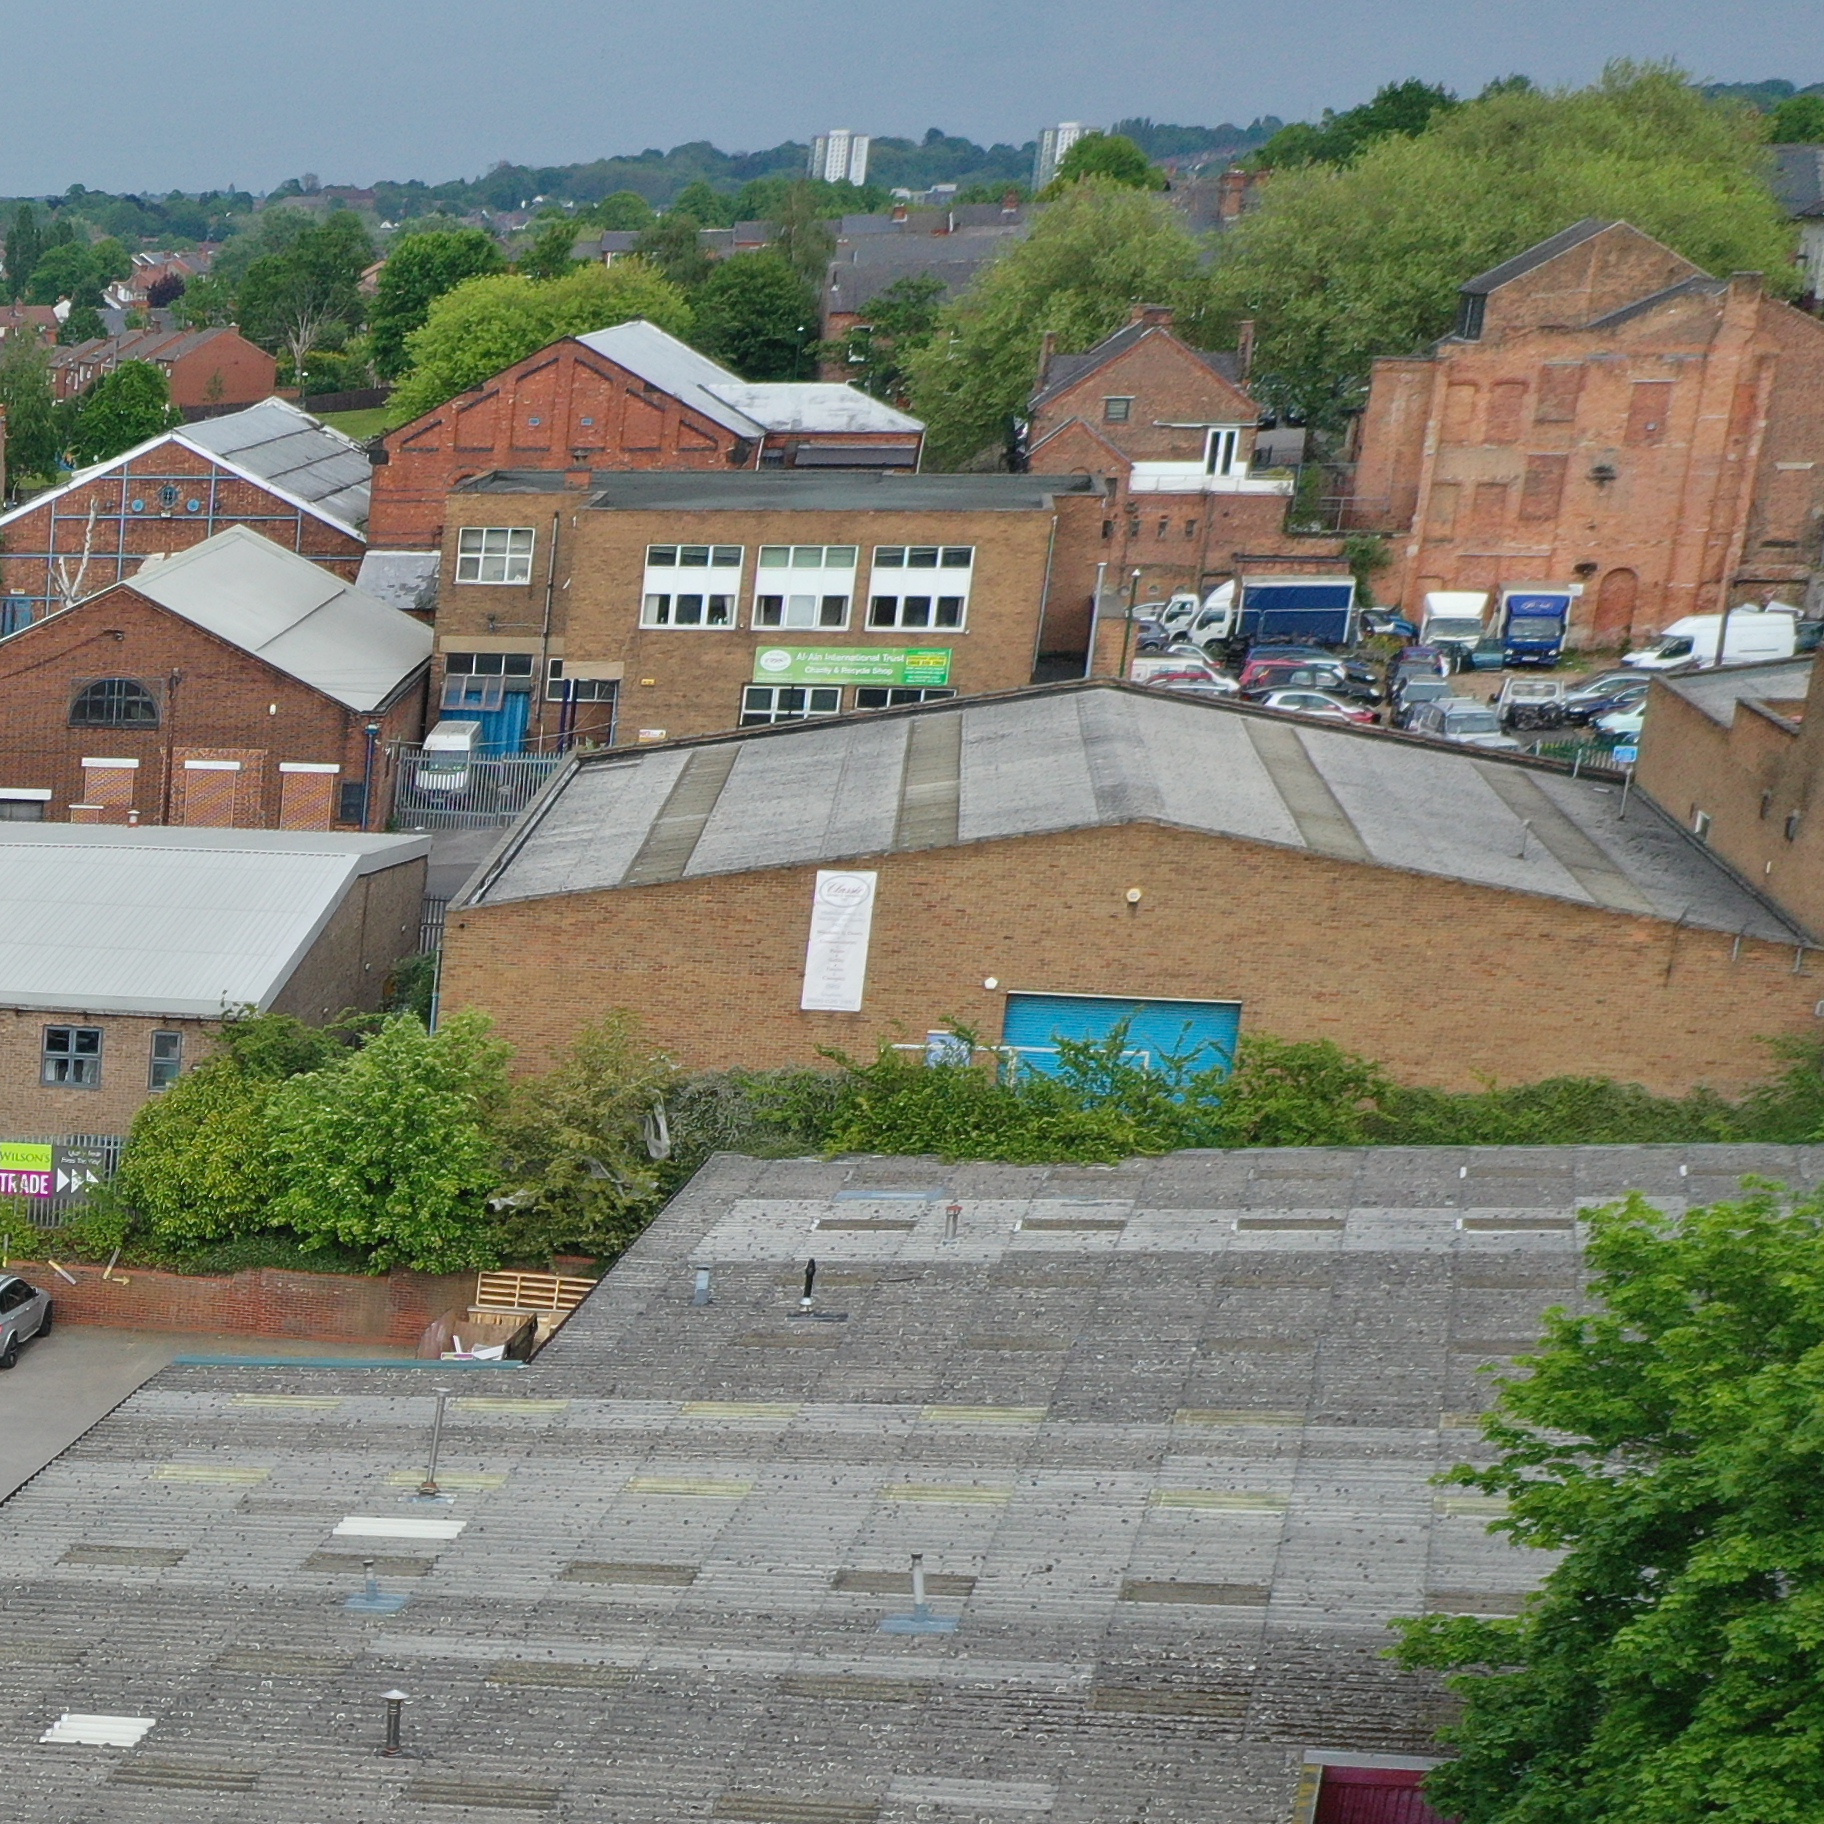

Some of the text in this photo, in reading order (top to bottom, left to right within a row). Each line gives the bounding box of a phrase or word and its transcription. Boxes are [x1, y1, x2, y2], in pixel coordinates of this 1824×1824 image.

[825, 653, 880, 662] International
[882, 653, 904, 662] Trust
[0, 1151, 50, 1163] WILSON'S
[0, 1172, 49, 1194] TRADE
